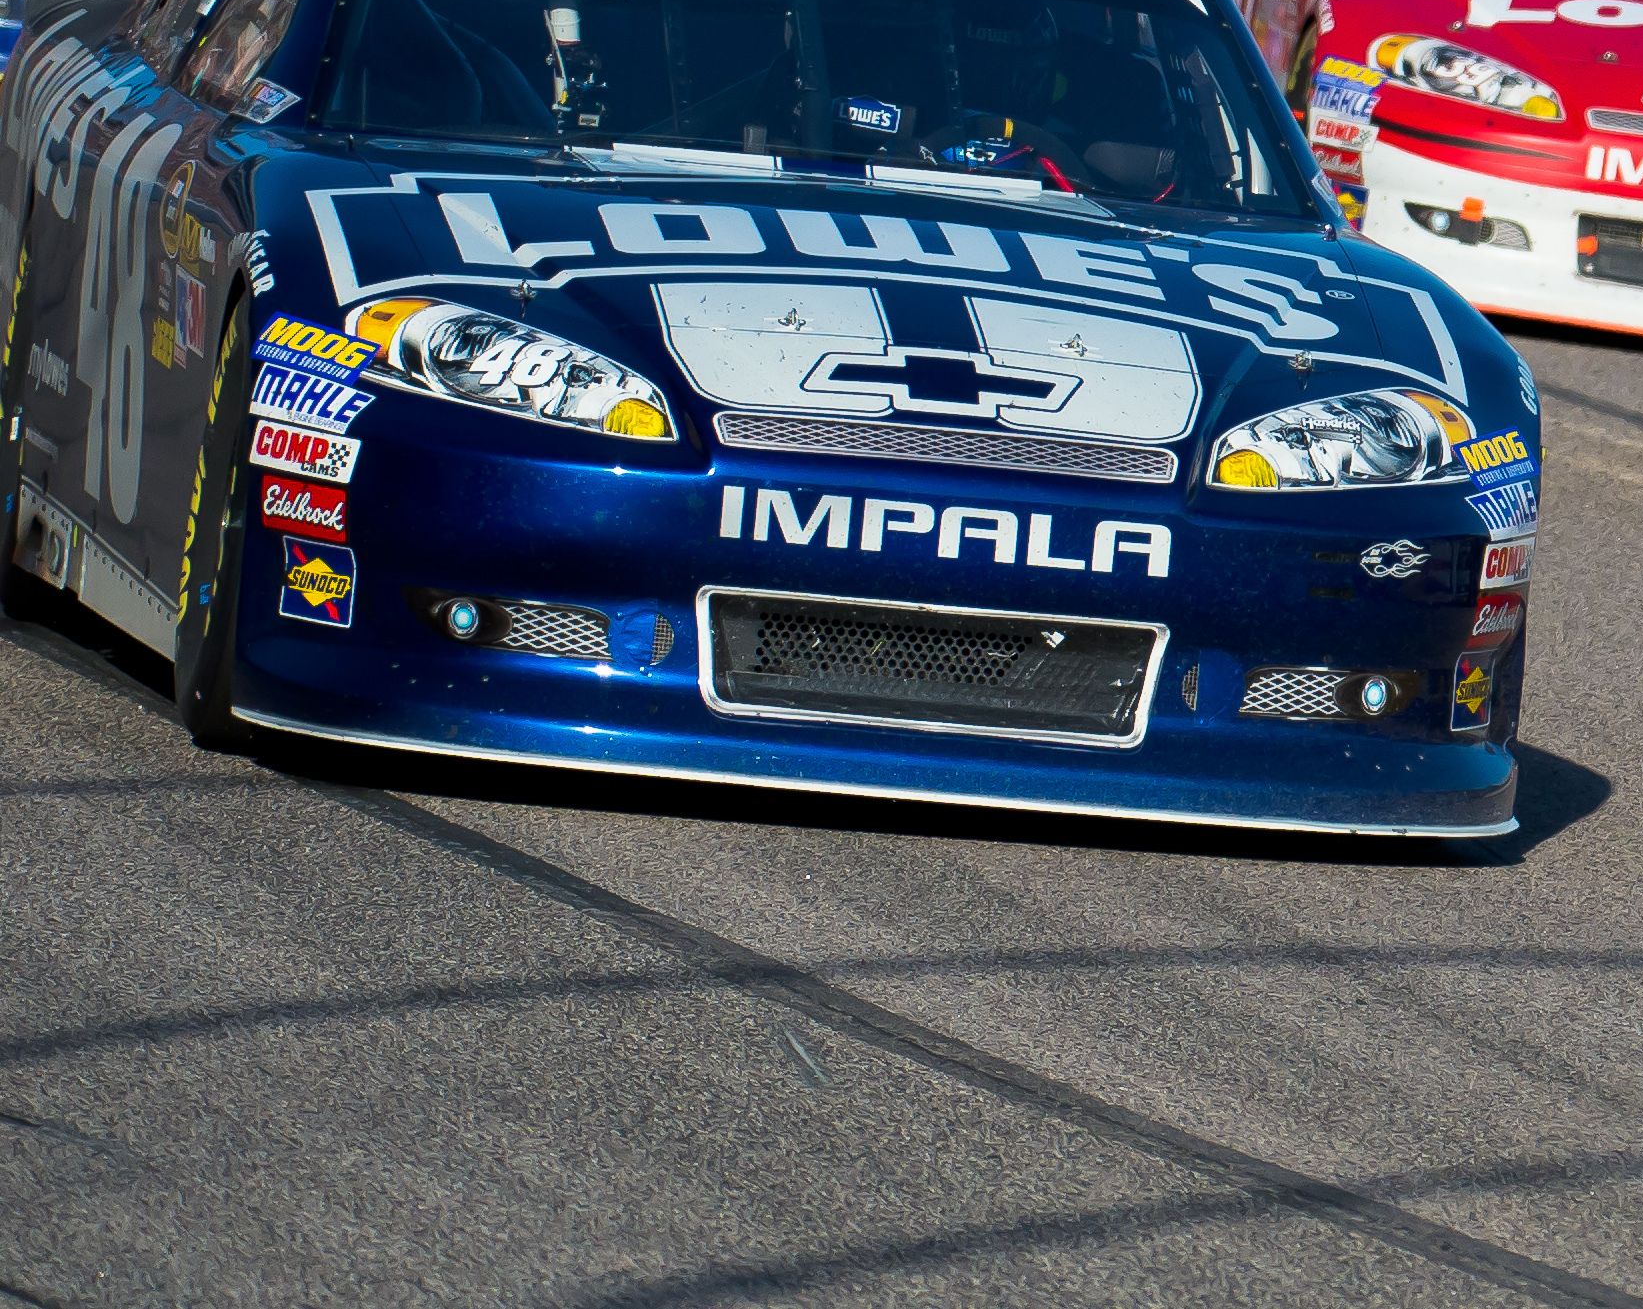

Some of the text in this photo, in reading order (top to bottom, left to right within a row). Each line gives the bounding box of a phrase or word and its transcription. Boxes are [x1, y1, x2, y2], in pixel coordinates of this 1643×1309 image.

[1322, 56, 1386, 88] MOOG
[1315, 119, 1361, 142] COMP
[437, 192, 1339, 341] LOWE'S
[76, 112, 183, 525] 48
[261, 316, 373, 370] MOOG
[469, 336, 571, 388] 48
[254, 372, 374, 423] MAHLE
[256, 427, 329, 463] COMP
[1301, 417, 1361, 432] Hendrick
[300, 460, 340, 478] CAMS
[1460, 431, 1528, 474] MOOG
[264, 484, 345, 532] Edelbrock
[720, 486, 1172, 578] IMPALA
[290, 568, 349, 596] SUNOCO
